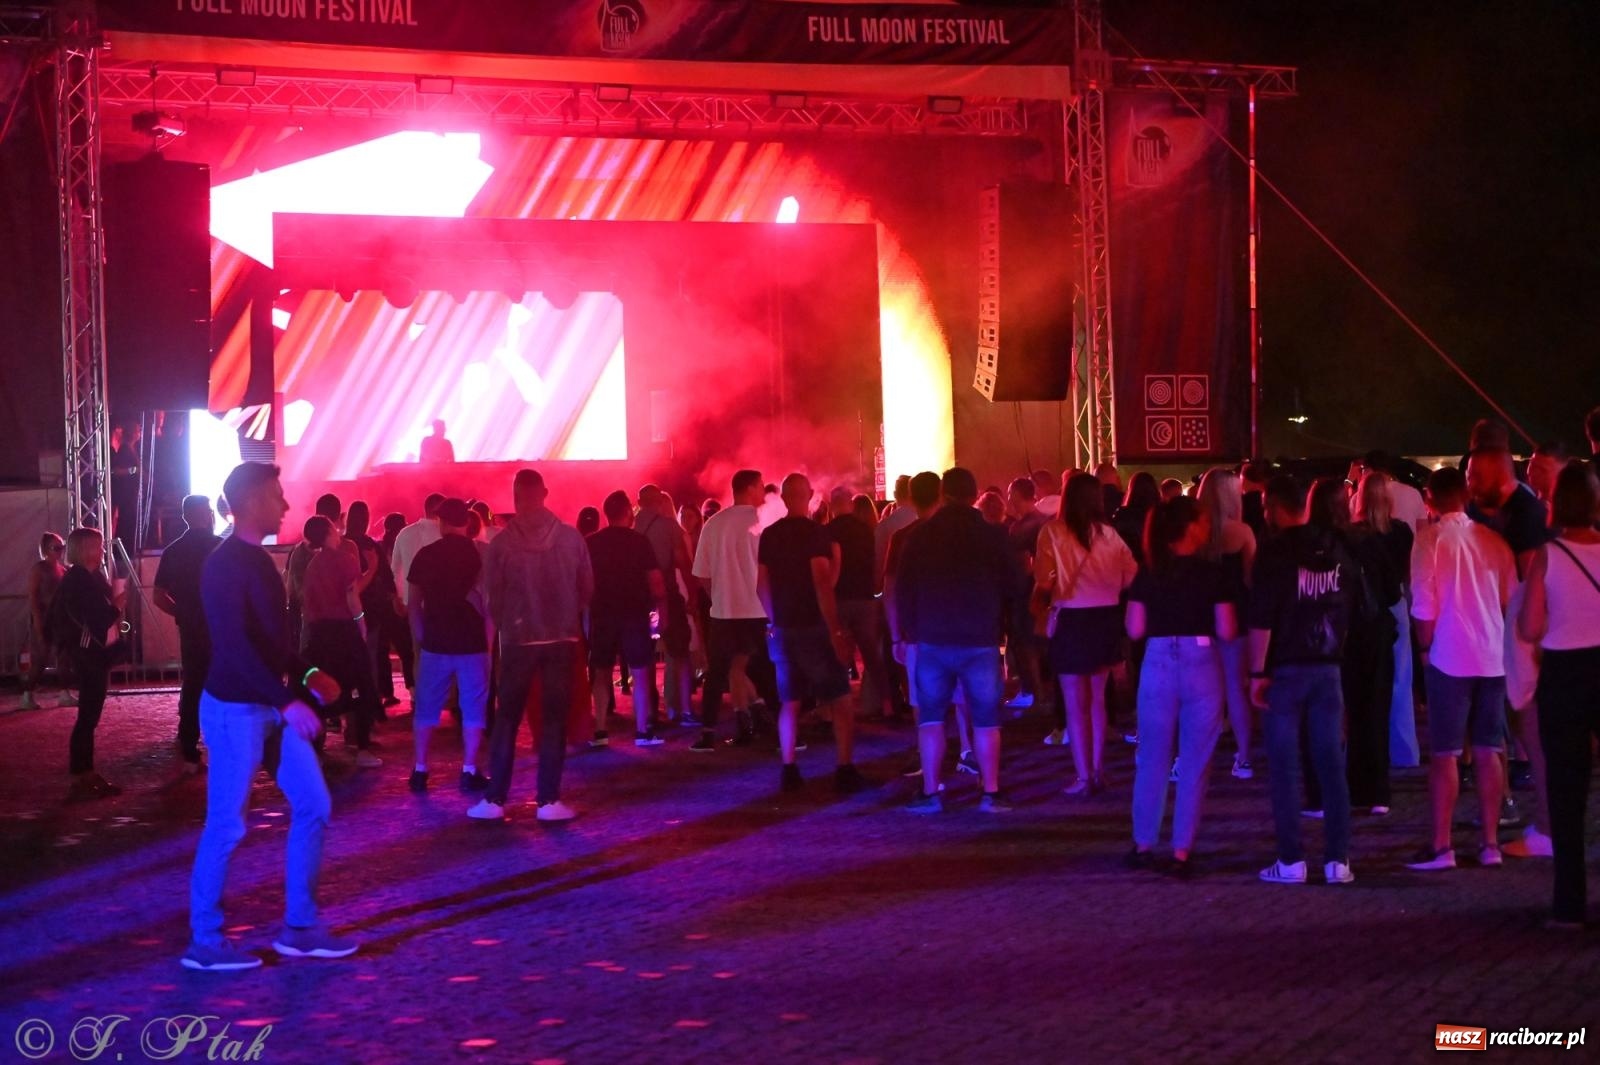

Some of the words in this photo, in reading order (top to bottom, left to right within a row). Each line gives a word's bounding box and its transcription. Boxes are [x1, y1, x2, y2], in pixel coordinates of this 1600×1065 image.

[315, 0, 418, 26] FESTIVAL
[808, 16, 855, 42] FULL
[861, 17, 916, 43] MOON
[923, 18, 1010, 45] FESTIVAL
